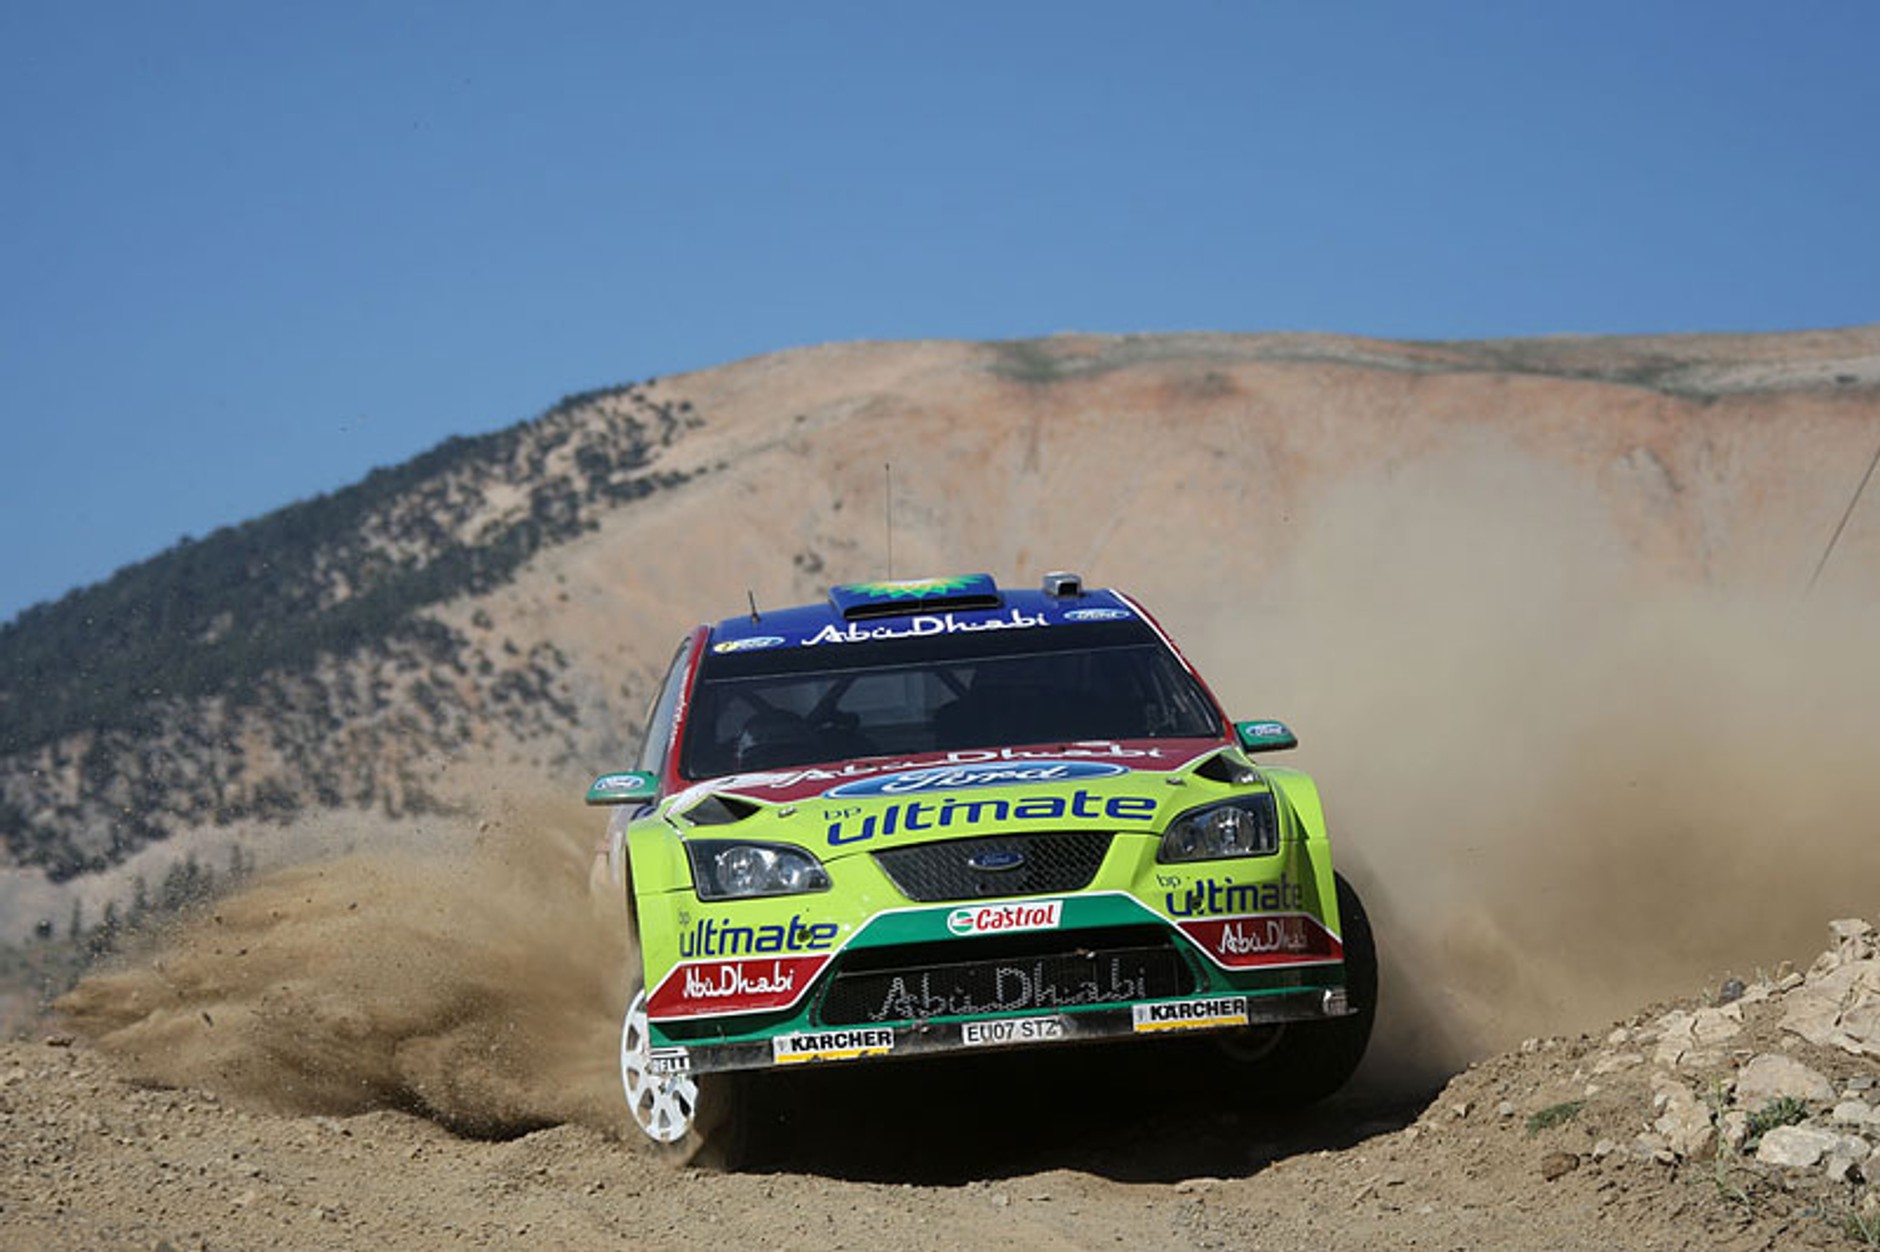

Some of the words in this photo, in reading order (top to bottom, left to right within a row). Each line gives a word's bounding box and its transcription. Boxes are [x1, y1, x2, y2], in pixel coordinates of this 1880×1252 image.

[882, 764, 1068, 793] Ford
[823, 807, 862, 822] bp
[827, 790, 1158, 847] ultimate
[976, 904, 1055, 931] Castrol
[679, 914, 839, 958] ultimate
[967, 1022, 1014, 1042] EU07
